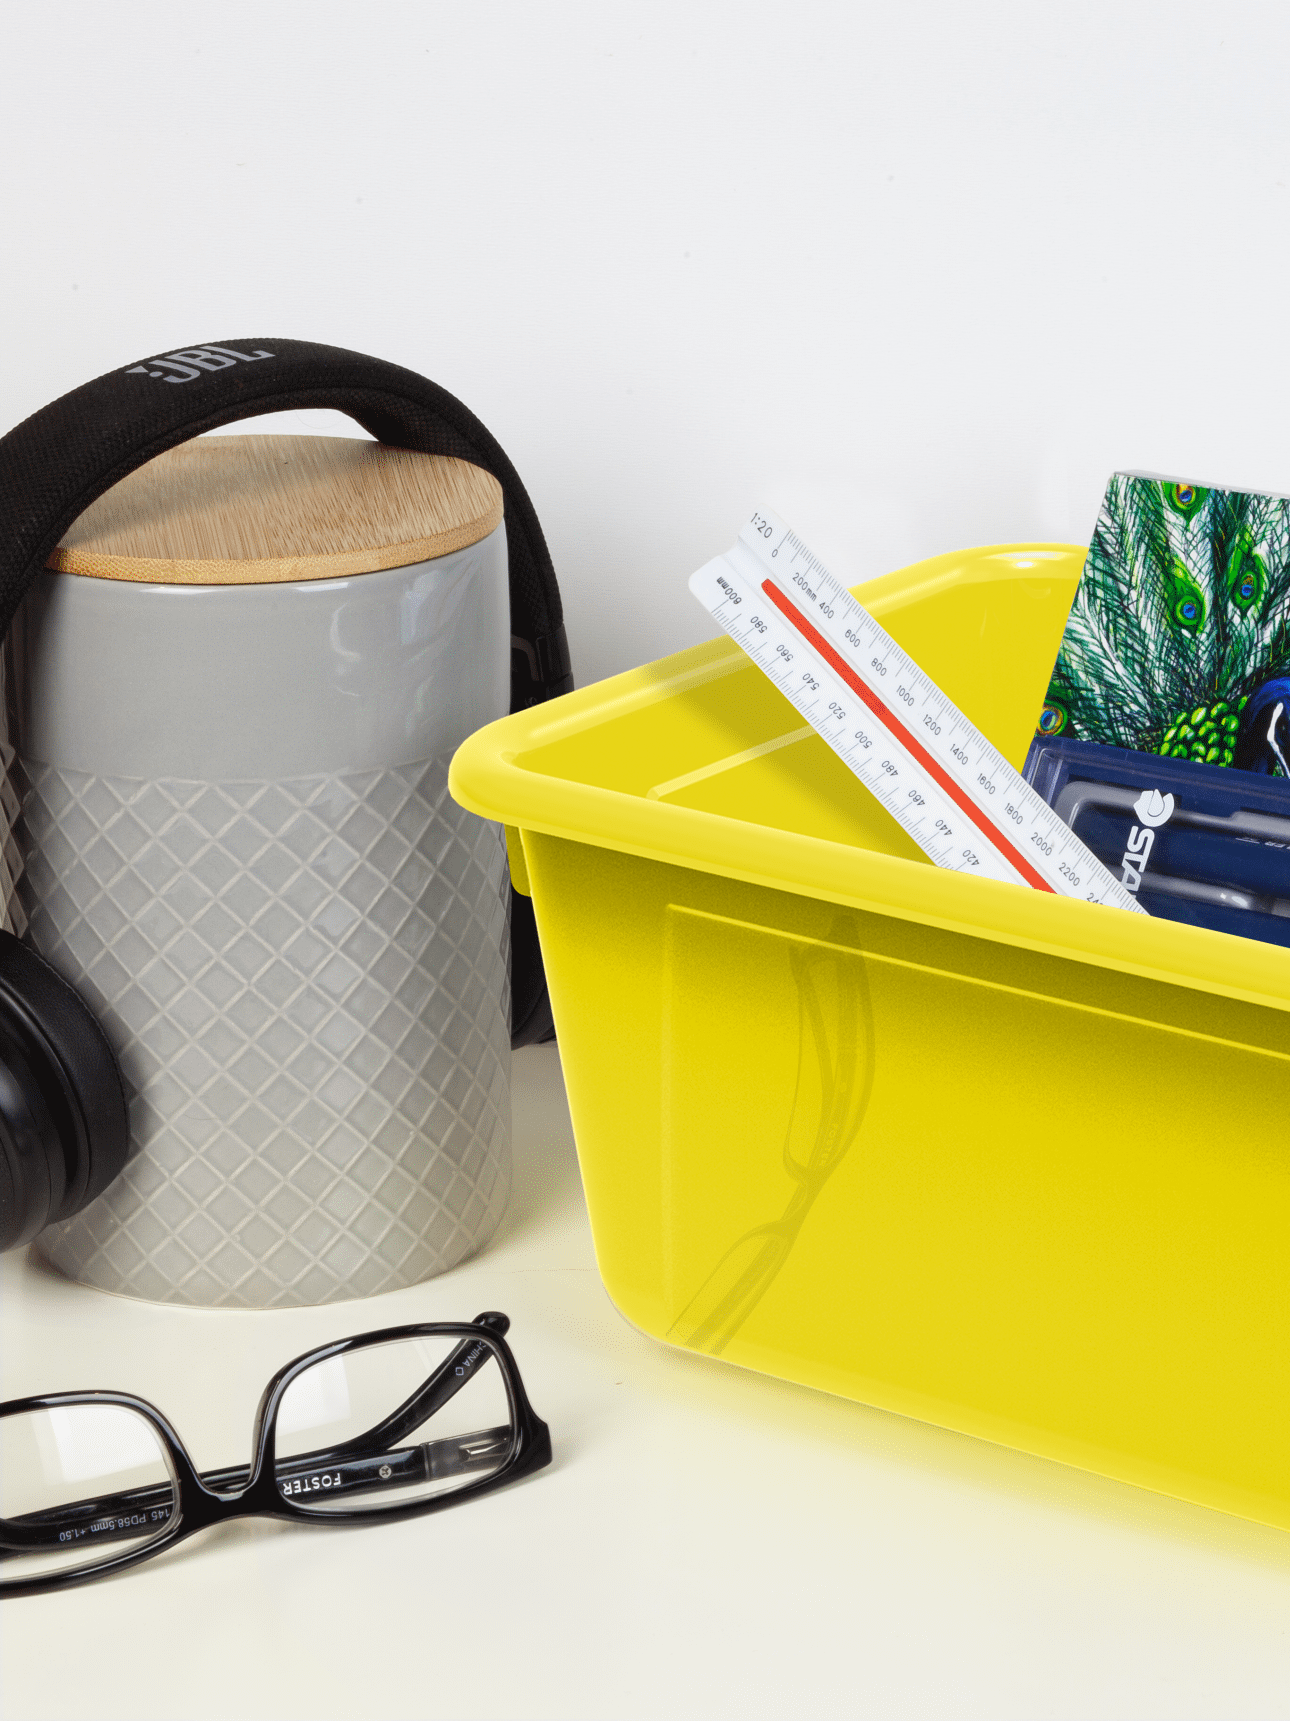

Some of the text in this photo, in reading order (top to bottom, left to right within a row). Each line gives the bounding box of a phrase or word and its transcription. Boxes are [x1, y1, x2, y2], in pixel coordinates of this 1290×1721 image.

[148, 345, 276, 384] JBL
[750, 512, 773, 539] 1:20
[716, 576, 980, 866] 420 440 460 480 500 520 540 560 580 600mm
[792, 572, 817, 602] 200mm
[819, 601, 835, 619] 400
[844, 629, 861, 648] 600
[871, 657, 887, 677] 800
[896, 685, 915, 707] 1000
[922, 714, 942, 736] 1200
[950, 743, 969, 766] 1400
[977, 773, 996, 795] 1600
[1004, 802, 1024, 826] 1800
[1030, 831, 1053, 857] 2000
[1058, 862, 1080, 887] 2200
[1121, 825, 1155, 900] STA
[283, 1472, 342, 1496] FOSTER
[59, 1508, 170, 1542] 145 PD58.5mm +1.50
